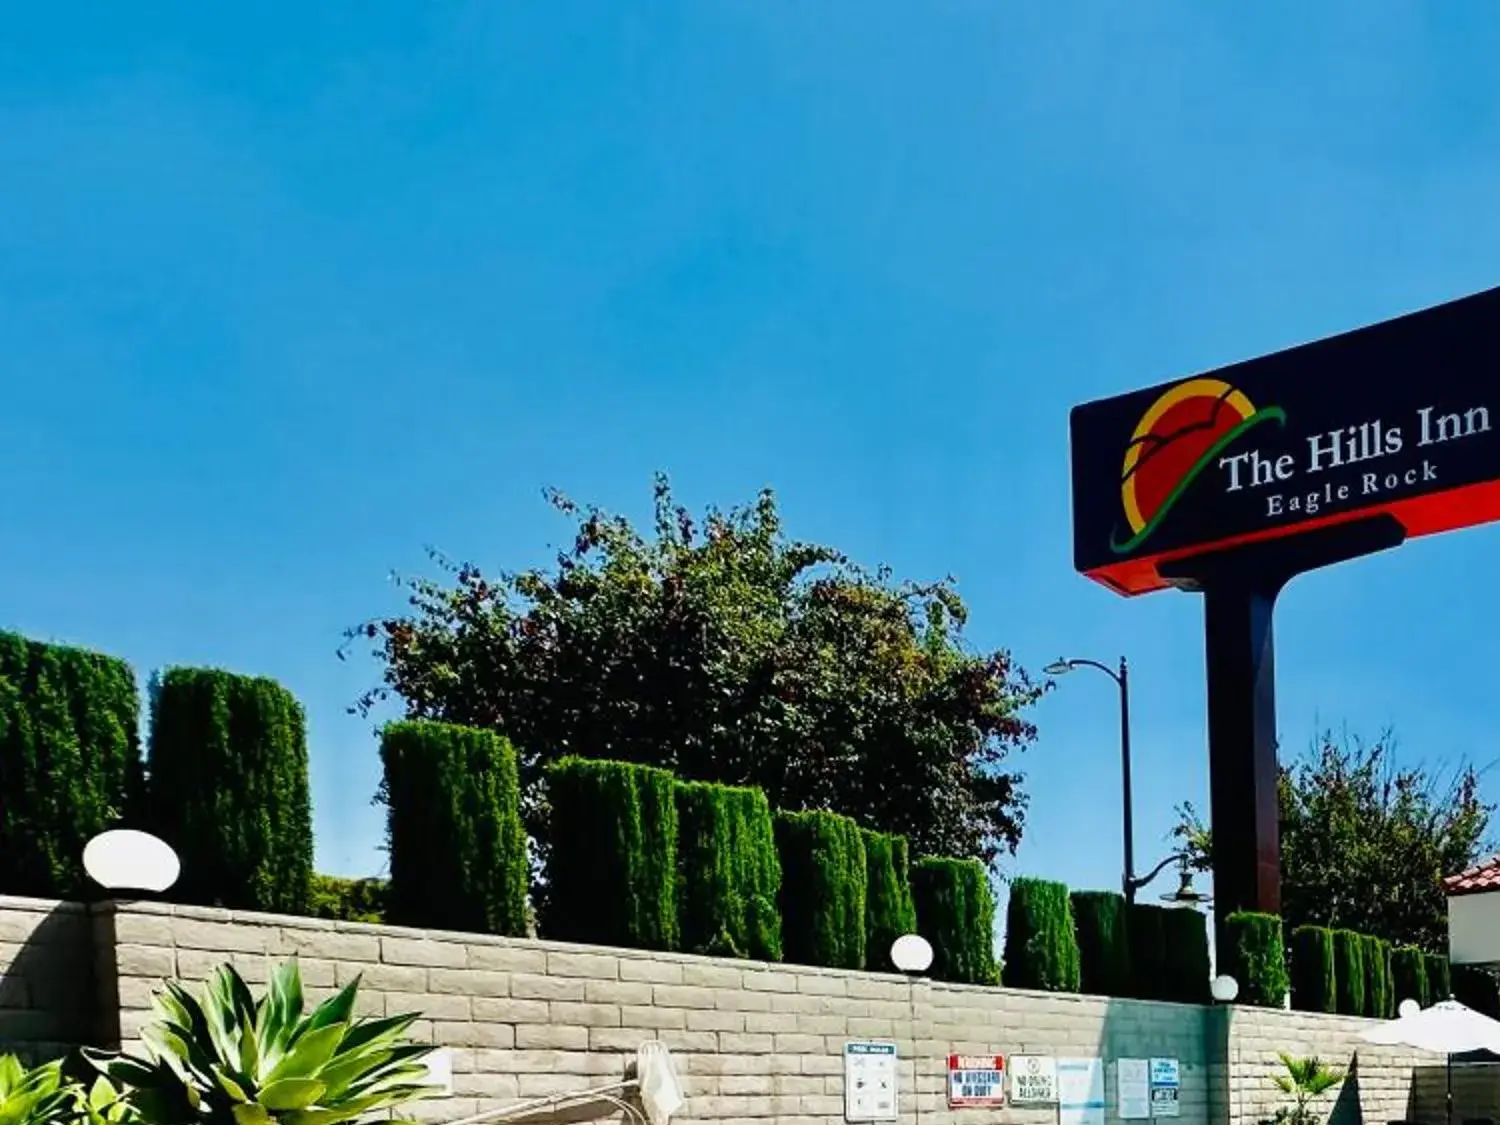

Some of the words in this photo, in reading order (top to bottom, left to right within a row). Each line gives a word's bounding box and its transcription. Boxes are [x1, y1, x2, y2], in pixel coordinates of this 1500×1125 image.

[1219, 449, 1295, 493] The
[1305, 418, 1403, 474] Hills
[1416, 404, 1492, 447] Inn
[1266, 483, 1349, 517] Eagle
[1361, 460, 1438, 496] Rock
